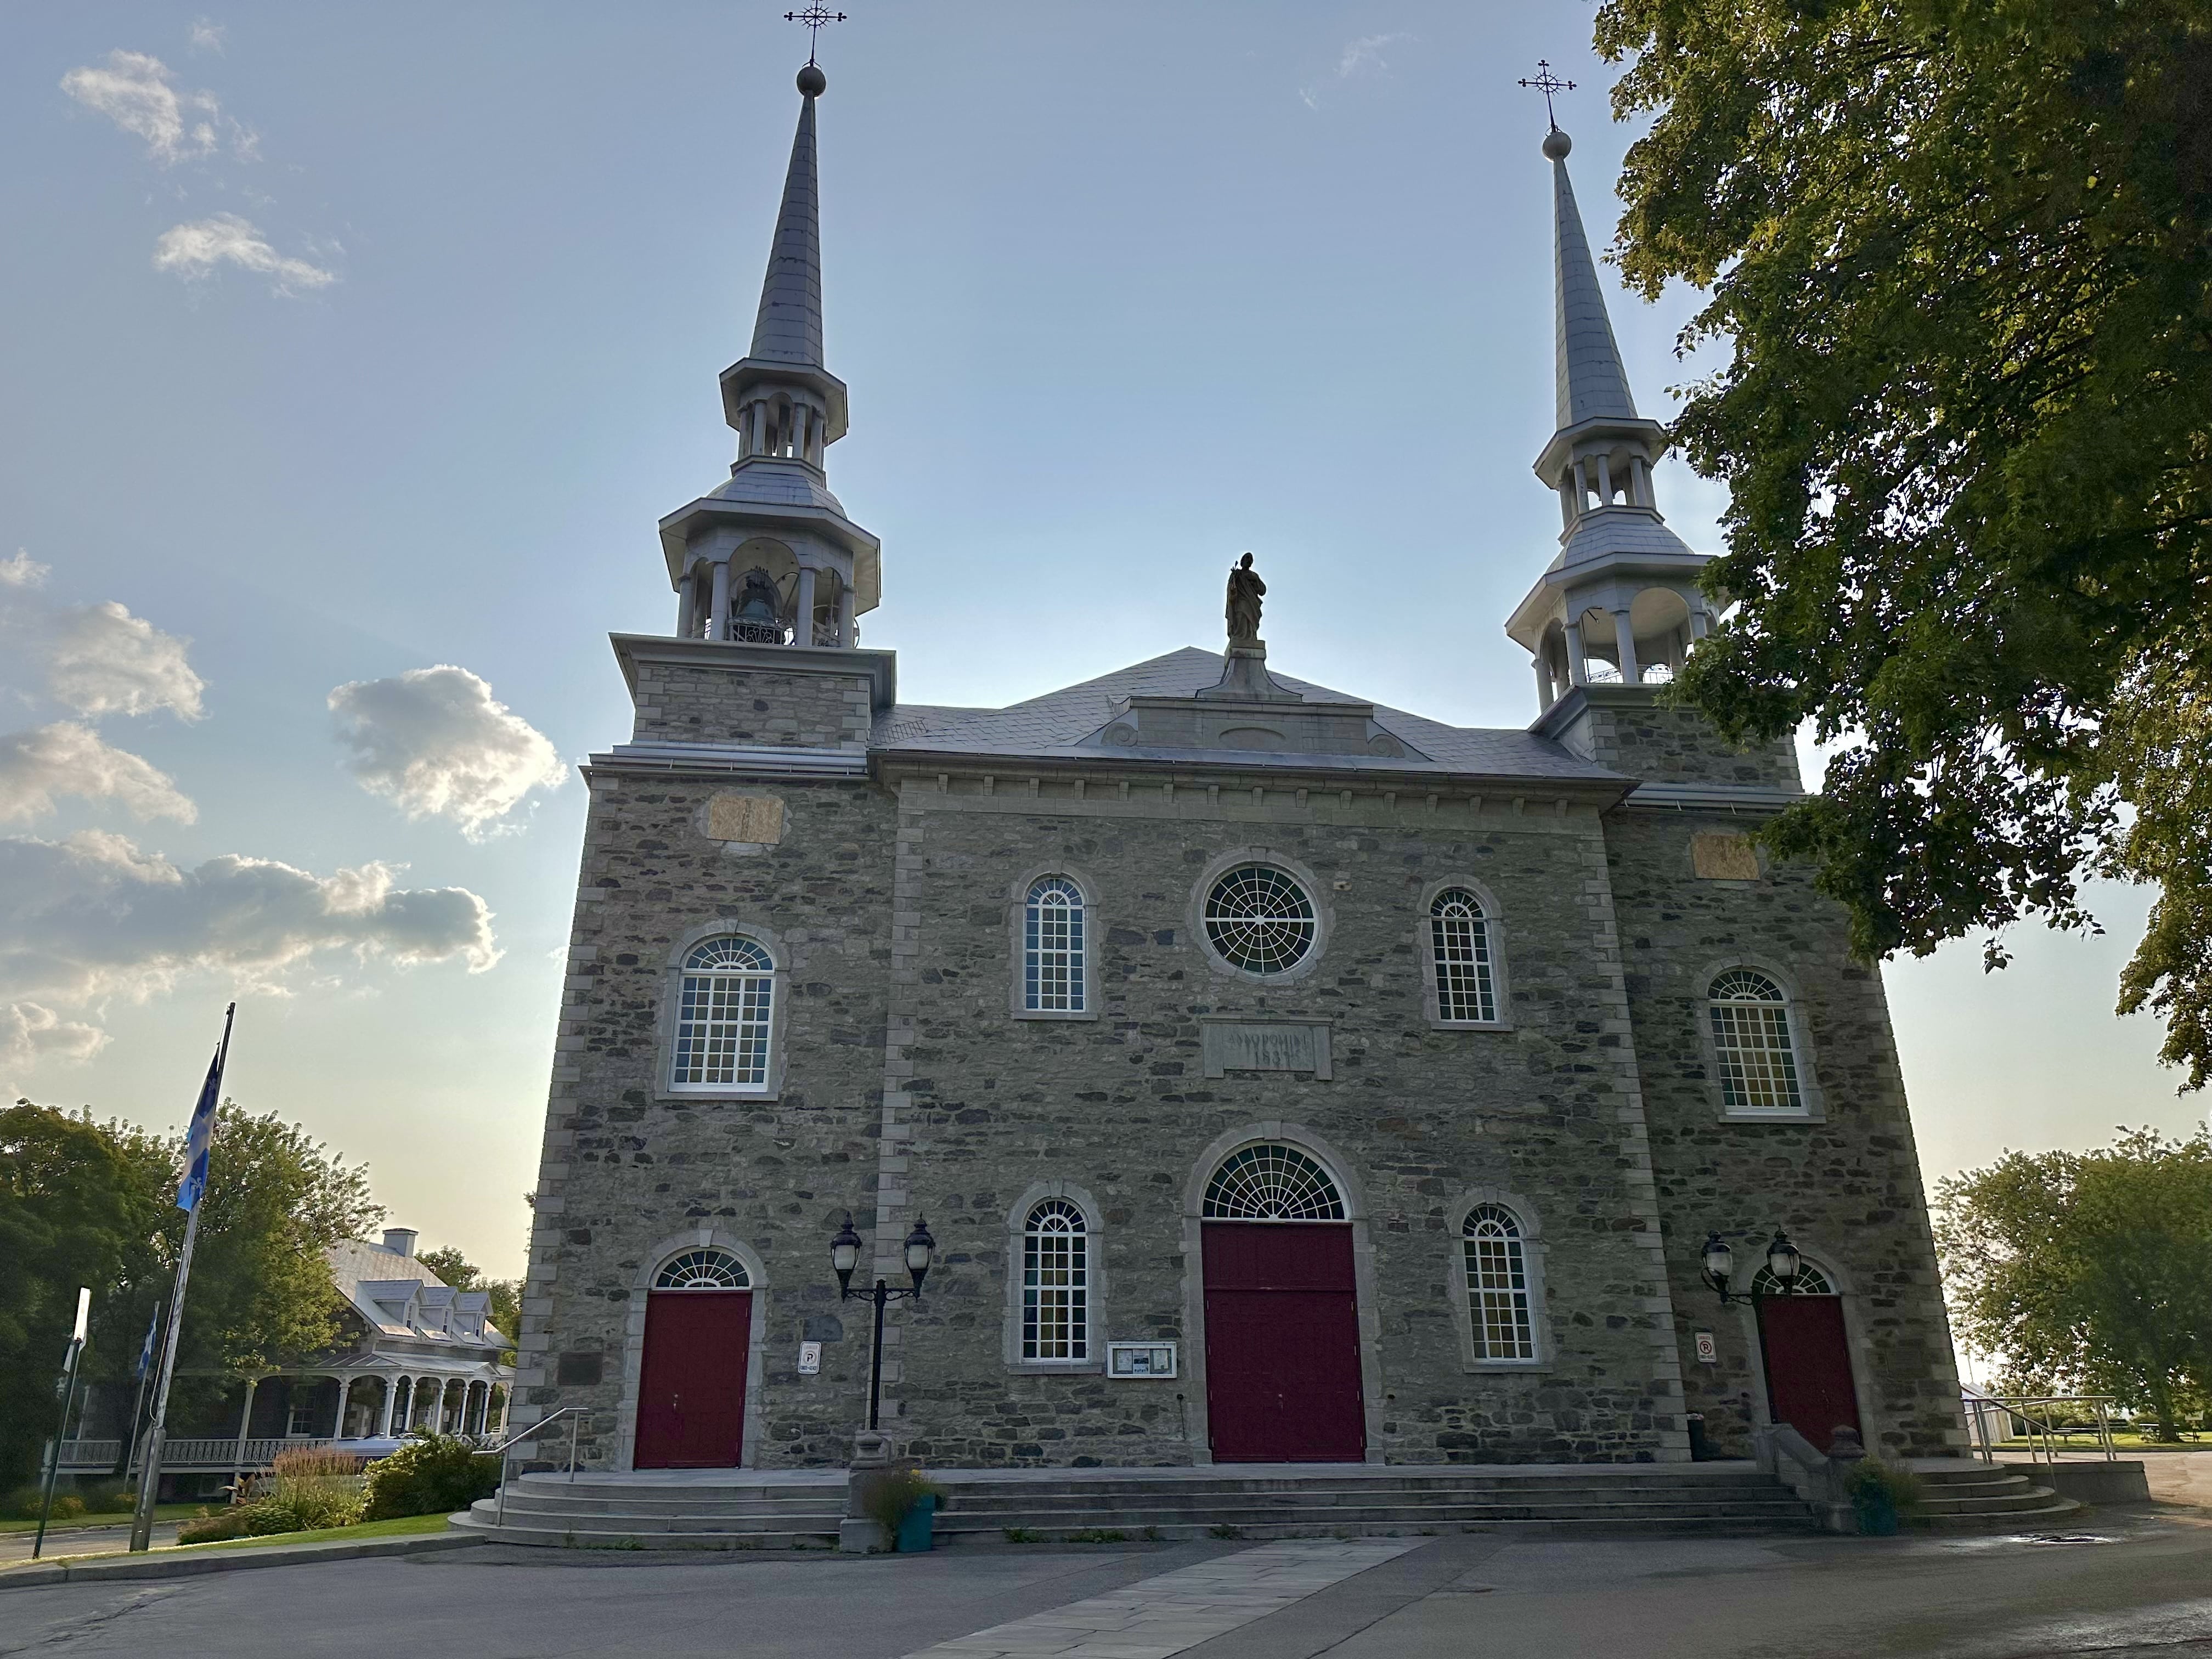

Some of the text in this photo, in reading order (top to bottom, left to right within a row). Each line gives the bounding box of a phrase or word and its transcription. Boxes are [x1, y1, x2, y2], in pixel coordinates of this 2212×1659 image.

[1228, 1033, 1307, 1046] ANNO DOMINI
[807, 1353, 813, 1362] P
